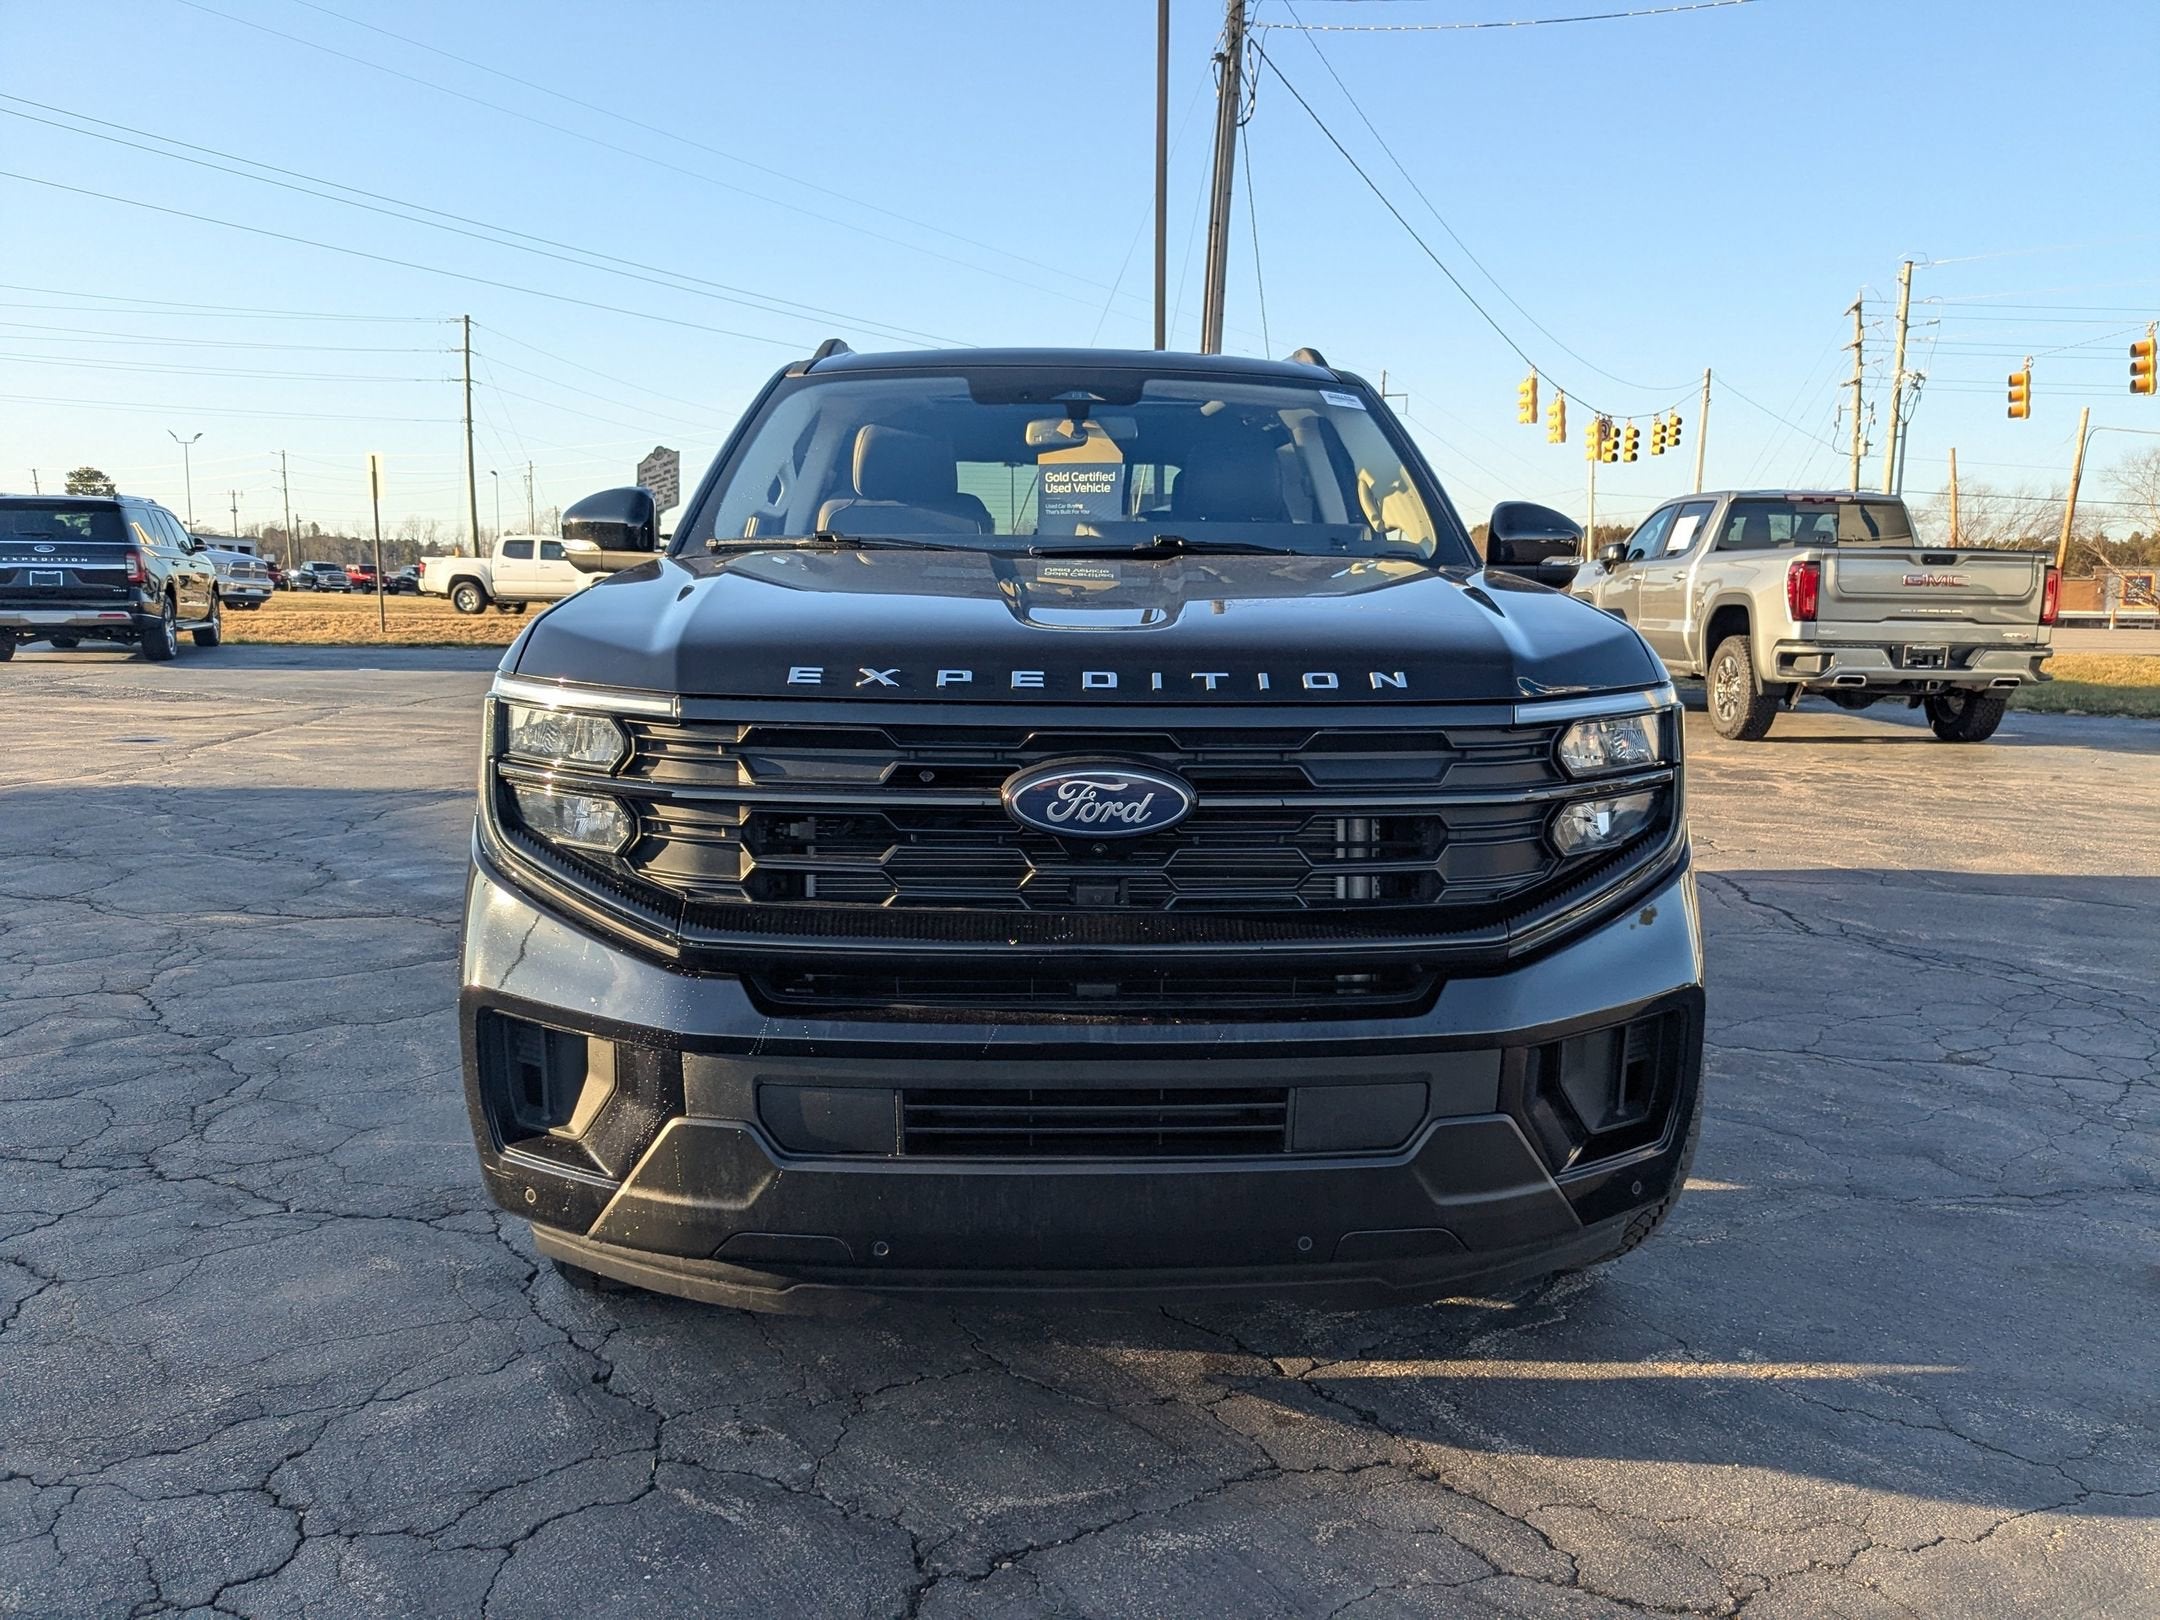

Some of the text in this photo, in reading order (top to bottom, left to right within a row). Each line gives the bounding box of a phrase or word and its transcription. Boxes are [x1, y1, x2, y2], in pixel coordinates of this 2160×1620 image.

[1045, 471, 1116, 482] Gold Certified
[1045, 482, 1111, 493] Used Vehicle
[1902, 574, 1970, 587] GMC
[787, 666, 1408, 690] EXPEDITION
[1046, 780, 1155, 823] Ford
